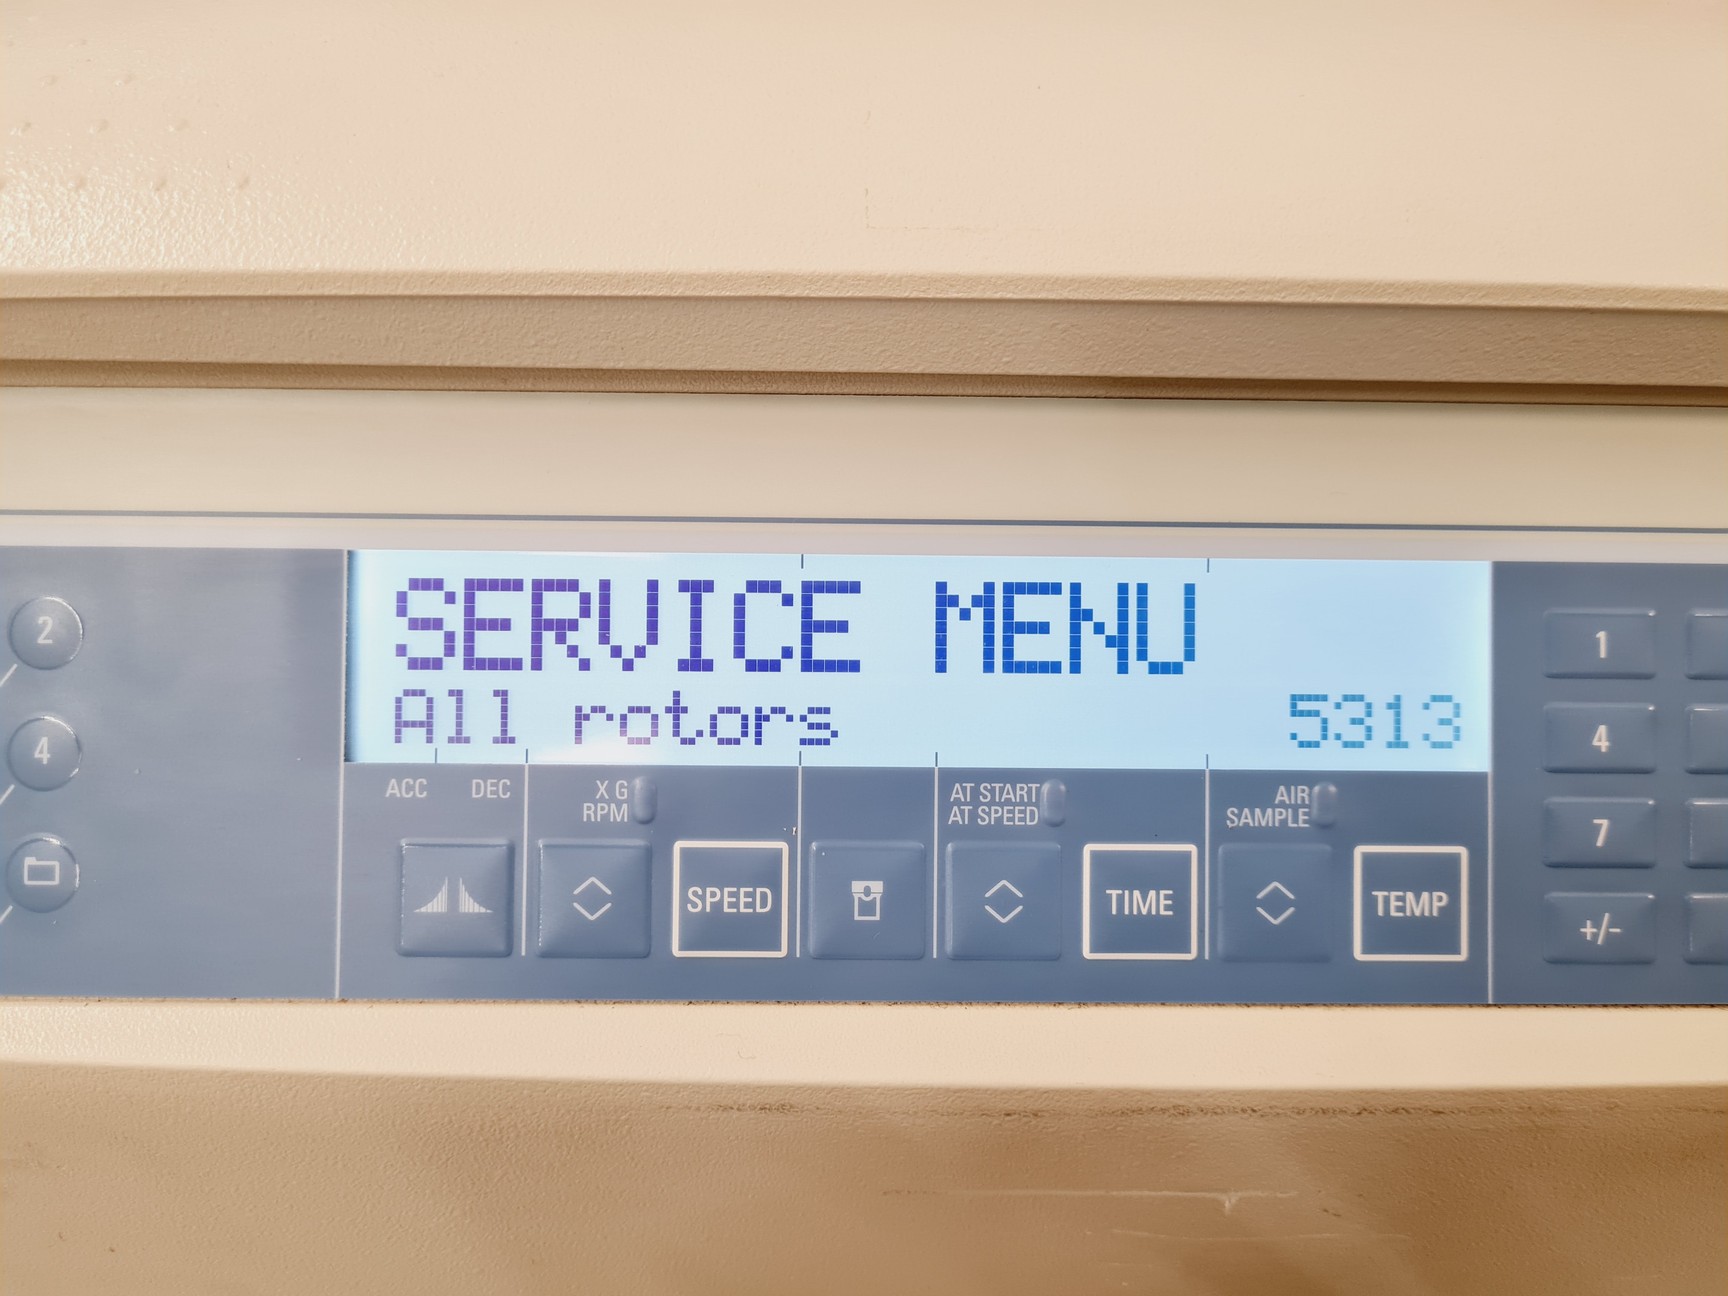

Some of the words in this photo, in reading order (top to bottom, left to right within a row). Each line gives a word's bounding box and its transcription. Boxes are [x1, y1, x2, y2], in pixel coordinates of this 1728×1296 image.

[37, 616, 53, 644] 2
[396, 578, 860, 672] SERVICE
[935, 581, 1196, 675] MENU
[1595, 631, 1608, 658] 1
[395, 689, 516, 744] All
[575, 690, 838, 745] rotors
[1290, 694, 1462, 748] 5313
[34, 737, 51, 764] 4
[1591, 725, 1610, 752] 4
[385, 778, 428, 799] ACC
[471, 779, 511, 799] DEC
[949, 783, 975, 803] AT
[979, 783, 1041, 803] START
[1274, 785, 1311, 805] AIR
[582, 803, 629, 823] RPM
[948, 806, 973, 826] AT
[977, 806, 1040, 826] SPEED
[1226, 807, 1311, 828] SAMPLE
[1592, 819, 1610, 847] 7
[686, 886, 773, 915] SPEED
[1106, 889, 1174, 916] TIME
[1371, 891, 1449, 917] TEMP
